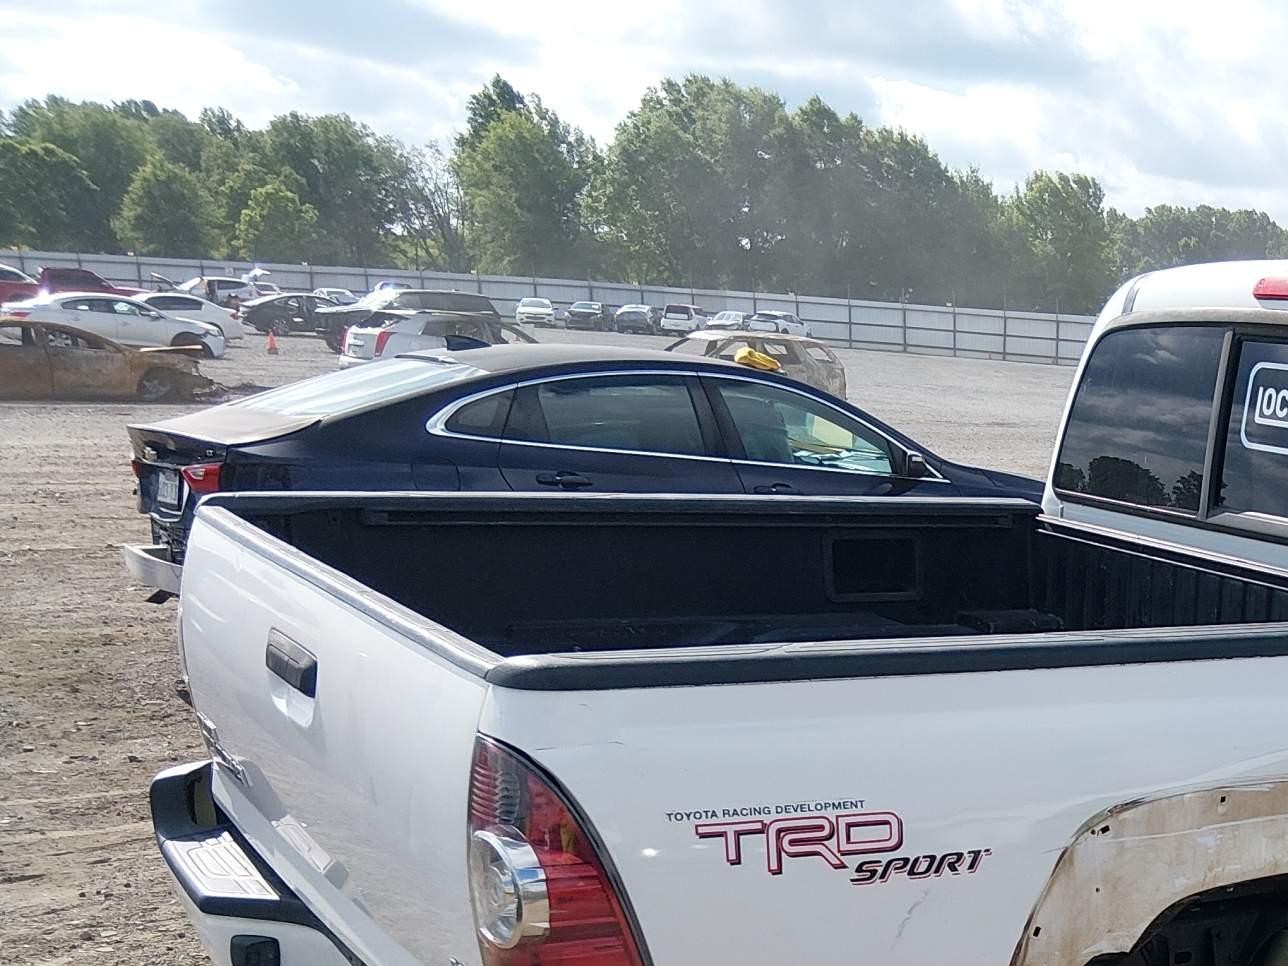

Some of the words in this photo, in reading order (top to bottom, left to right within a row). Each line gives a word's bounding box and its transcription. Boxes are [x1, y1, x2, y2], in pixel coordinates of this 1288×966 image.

[665, 809, 719, 822] TOYOTA
[722, 805, 772, 818] RACING
[775, 799, 866, 815] DEVELOPMENT
[694, 811, 904, 876] TRD
[849, 849, 984, 886] SPORT
